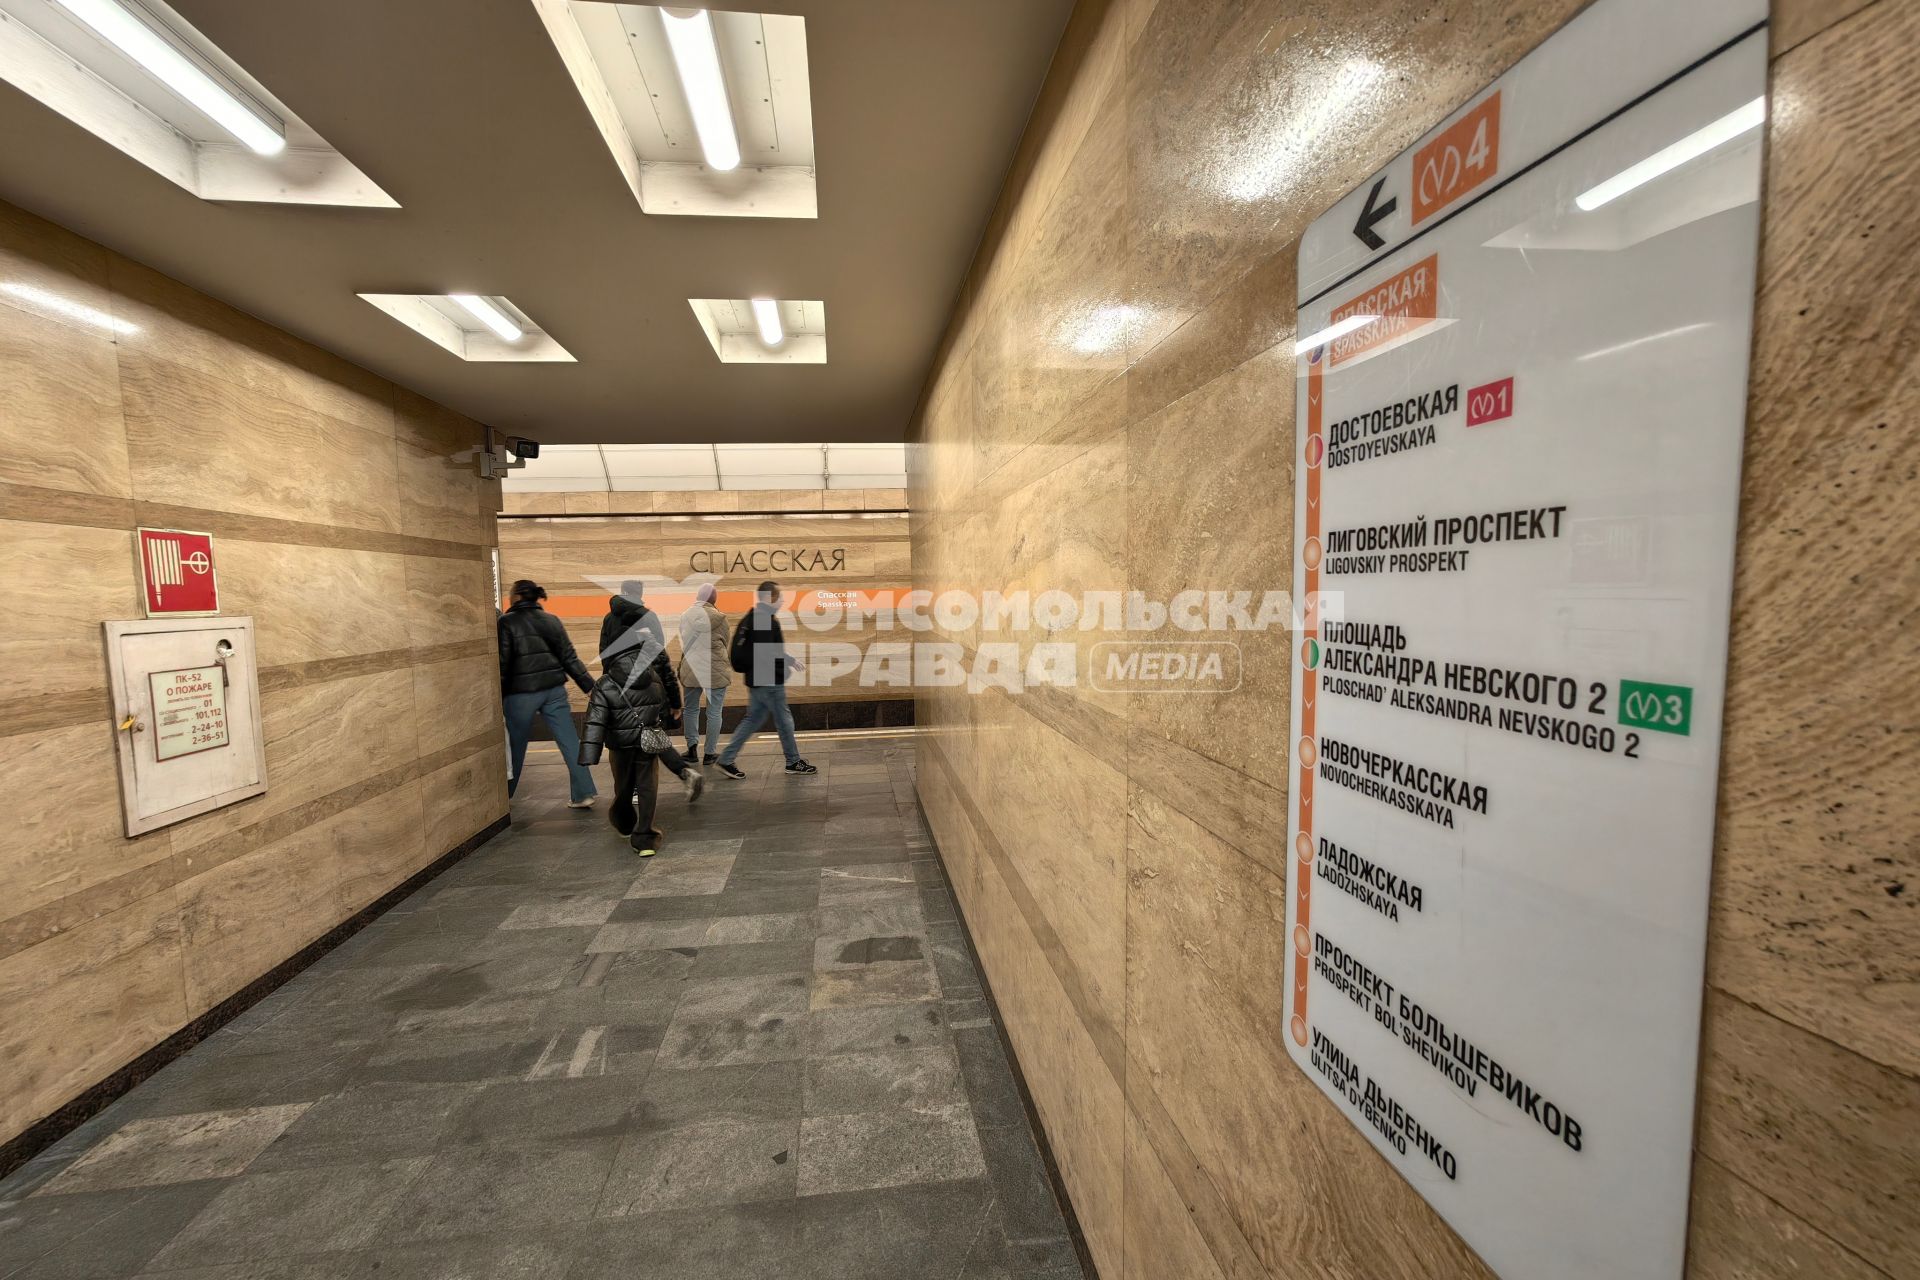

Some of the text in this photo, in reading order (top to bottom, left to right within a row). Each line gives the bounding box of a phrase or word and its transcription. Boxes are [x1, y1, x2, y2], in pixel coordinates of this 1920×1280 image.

[1465, 116, 1490, 170] 4
[1334, 309, 1406, 359] SPASSKAYA
[1328, 384, 1459, 451] ДОСТОЕВСКАЯ
[1498, 386, 1507, 413] 1
[1328, 425, 1436, 468] DOSTOYEVSKAYA
[1326, 507, 1567, 553] ЛИГОВСКИЙ ПРОСПЕКТ
[690, 548, 845, 573] СПАССКАЯ
[1326, 550, 1469, 574] LIGOVSKIY PROSPEKT
[817, 591, 857, 599] Спасская
[817, 600, 857, 608] Spasskaya
[1324, 621, 1407, 653] ПЛОЩАДЬ
[166, 682, 212, 696] О ПОЖАРЕ
[175, 673, 202, 684] ПК-52
[1324, 648, 1607, 715] АЛЕКСАНДРА НЕВСКОГО 2
[203, 699, 212, 708] 01
[1391, 687, 1493, 728] ALEKSANDRA
[1499, 707, 1615, 753] NEVSKOGO
[1624, 732, 1640, 759] 2
[1664, 695, 1683, 726] 3
[192, 720, 223, 734] 2-24-10
[192, 731, 224, 745] 2-36-51
[1320, 762, 1454, 829] NOVOCHERKASSKAYA
[1321, 737, 1488, 815] НОВОЧЕРКАССКАЯ
[1317, 860, 1399, 923] LADOZHSKAYA
[1318, 837, 1422, 912] ЛАДОЖСКАЯ
[1315, 956, 1371, 1013] PROSPEKT
[1315, 932, 1582, 1152] ПРОСПЕКТ БОЛЬШЕВИКОВ
[1311, 1049, 1407, 1155] ULITSA DYBENKO
[1312, 1026, 1457, 1180] УЛИЦА ДЫБЕНКО
